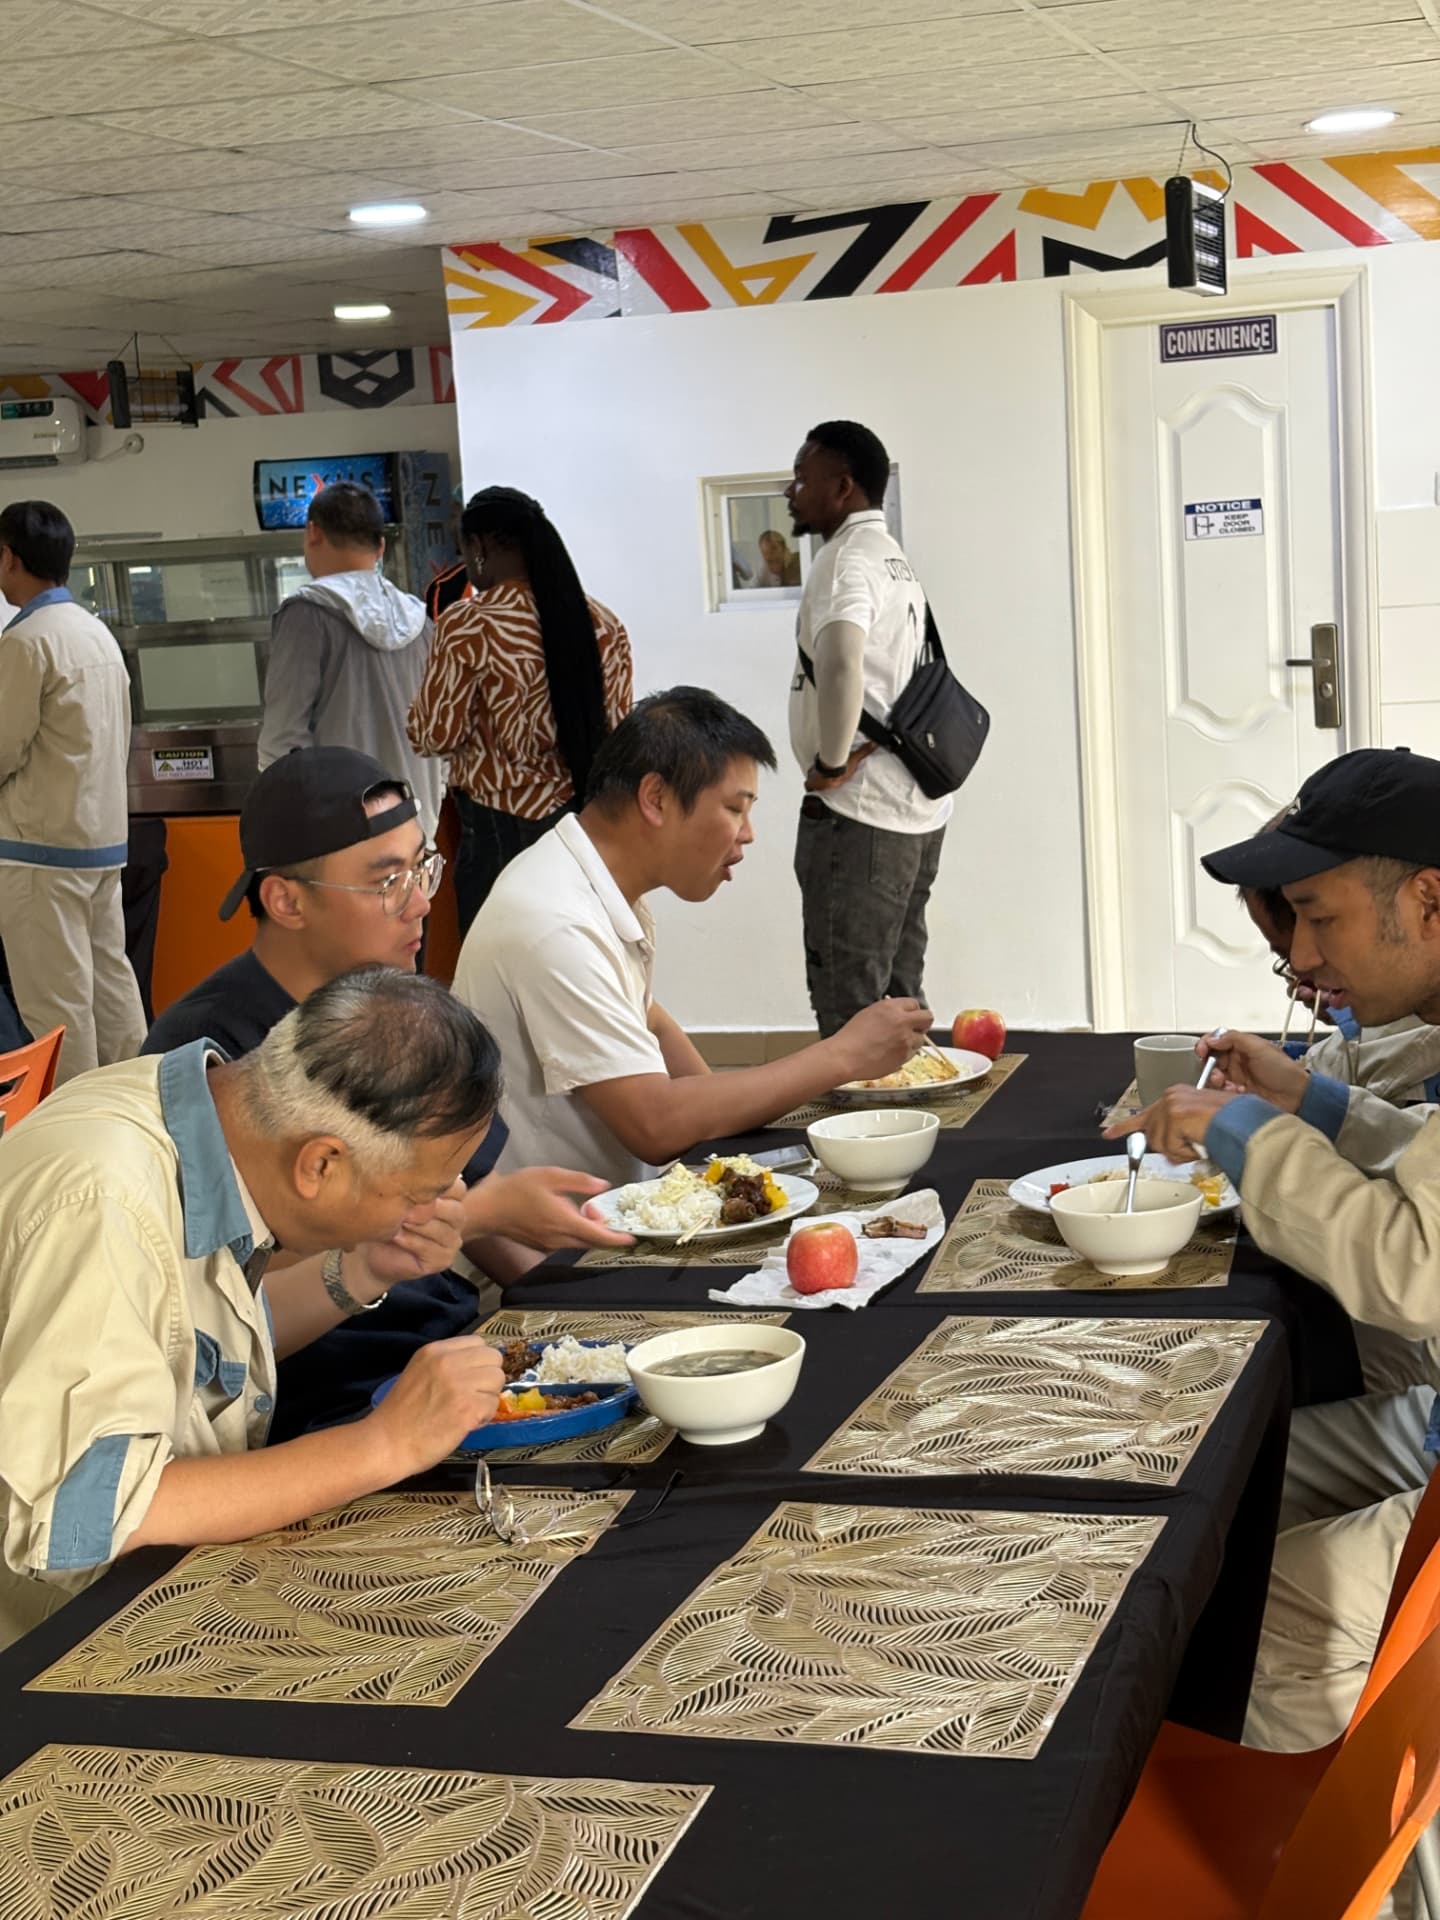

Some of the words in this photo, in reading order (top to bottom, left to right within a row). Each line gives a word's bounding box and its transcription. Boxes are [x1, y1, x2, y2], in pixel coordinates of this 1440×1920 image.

[1167, 323, 1270, 355] CONVENIENCE
[1195, 501, 1251, 513] NOTICE
[1218, 526, 1256, 534] CLOSED
[158, 751, 205, 759] CAUTION
